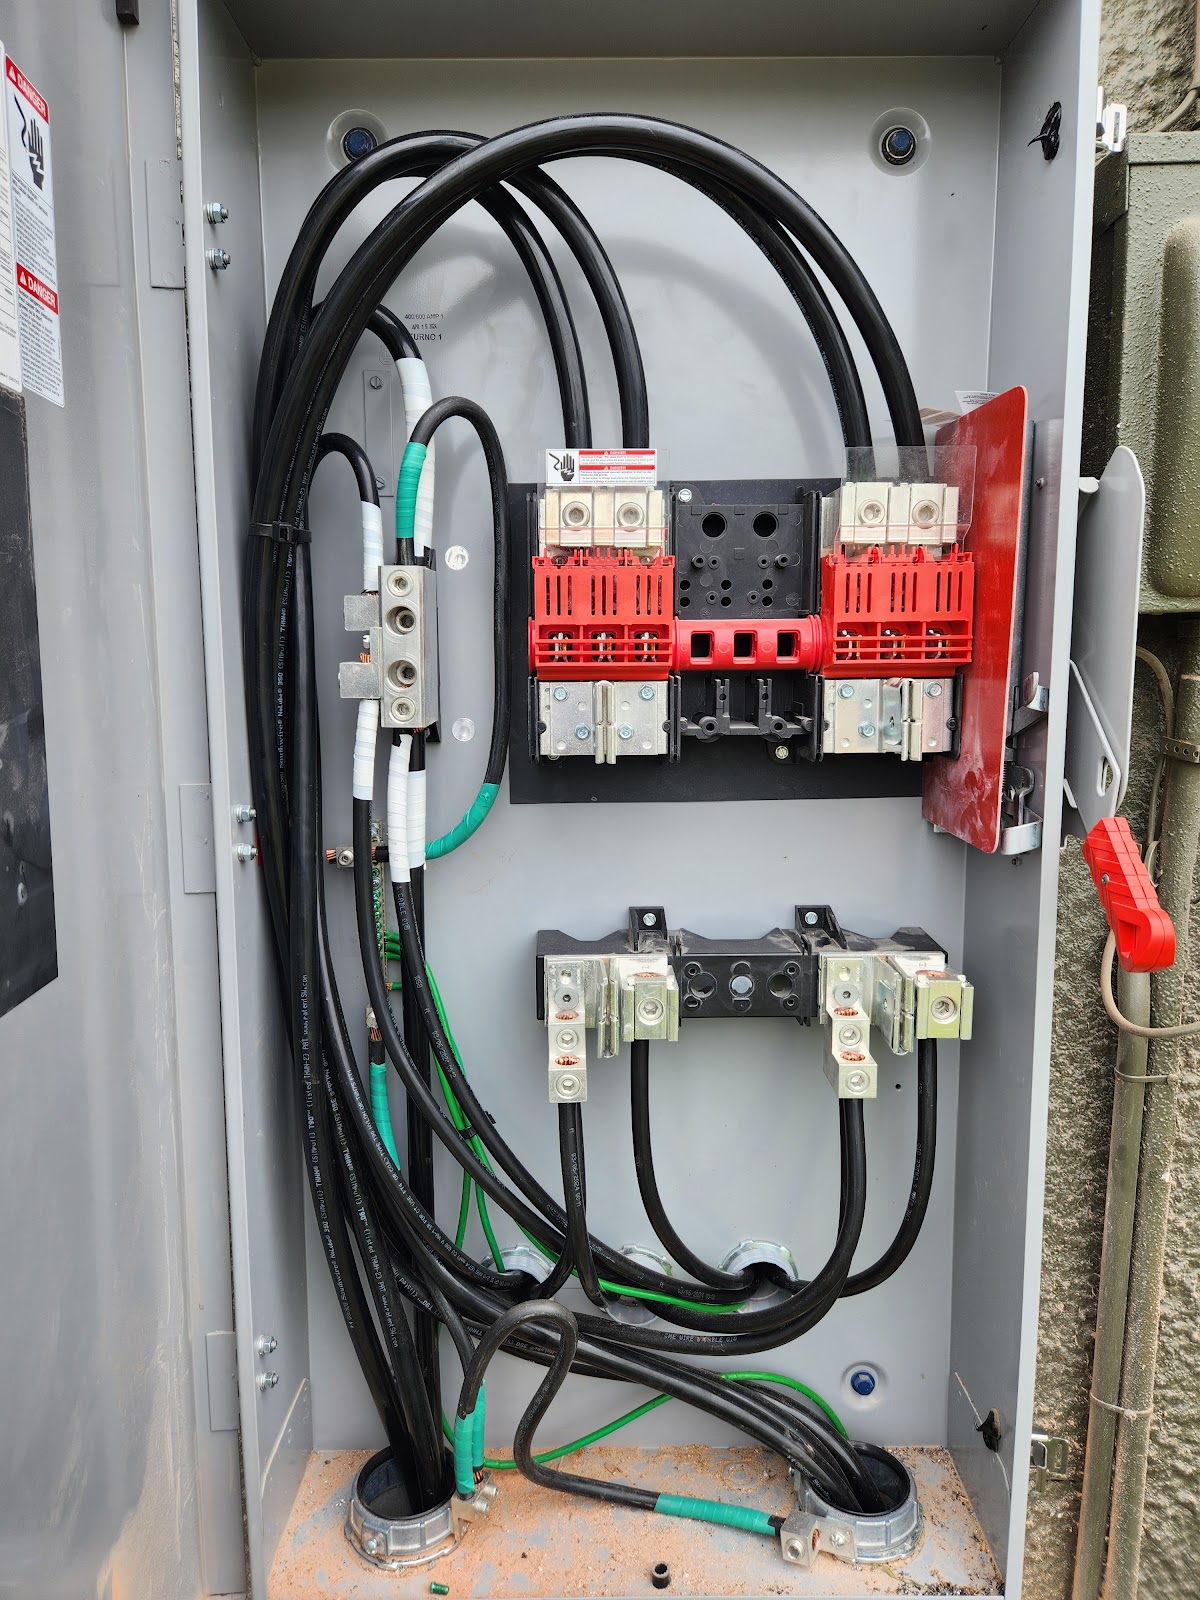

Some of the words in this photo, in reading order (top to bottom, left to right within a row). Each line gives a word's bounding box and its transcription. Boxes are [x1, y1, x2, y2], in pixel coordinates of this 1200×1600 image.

[16, 71, 48, 117] DANGER
[28, 271, 56, 309] DANGER
[330, 1098, 338, 1112] 350
[362, 1111, 372, 1130] NYLON
[375, 1142, 383, 1156] TYPE
[397, 1182, 408, 1194] FT4
[418, 1213, 428, 1223] FOR
[322, 1221, 330, 1232] 350
